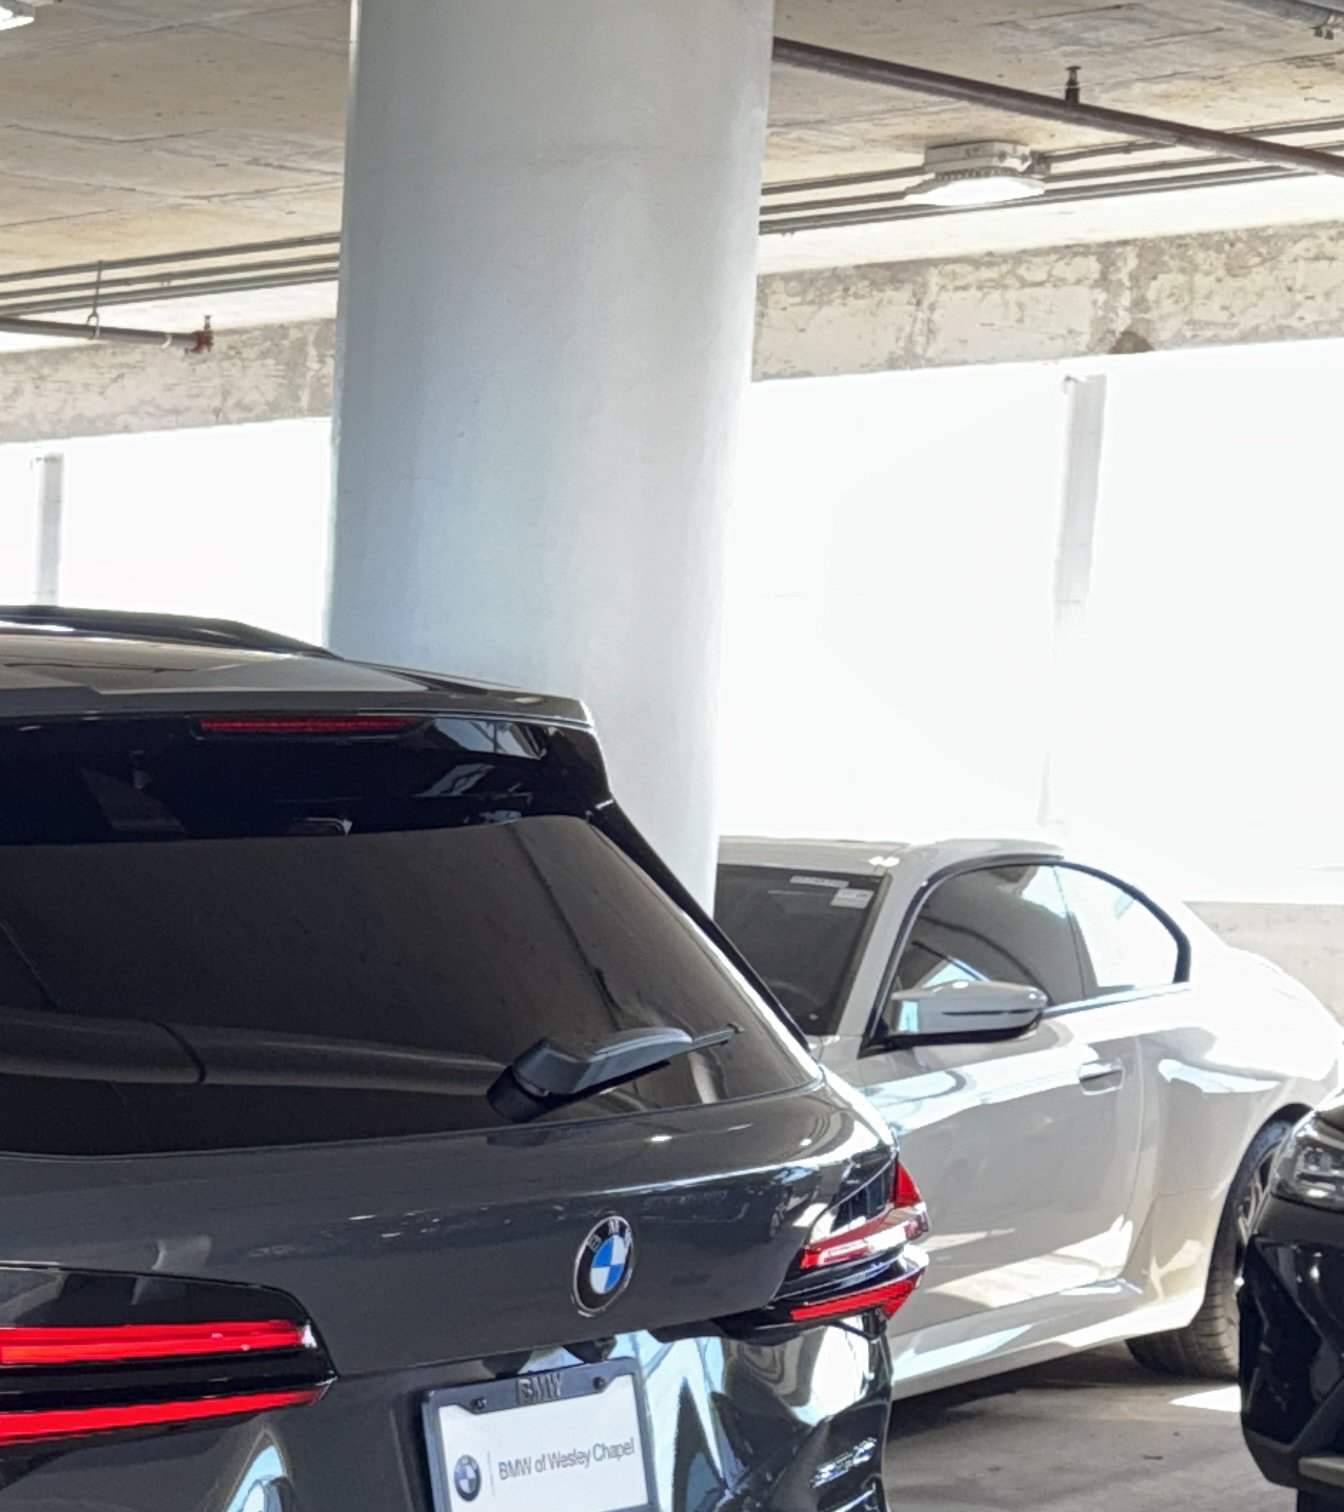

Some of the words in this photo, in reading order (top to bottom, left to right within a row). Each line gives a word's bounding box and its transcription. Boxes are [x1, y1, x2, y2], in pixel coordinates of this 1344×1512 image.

[498, 1456, 532, 1480] BMW
[534, 1453, 547, 1473] of
[547, 1448, 591, 1469] Wesley
[592, 1436, 636, 1462] Chapel
